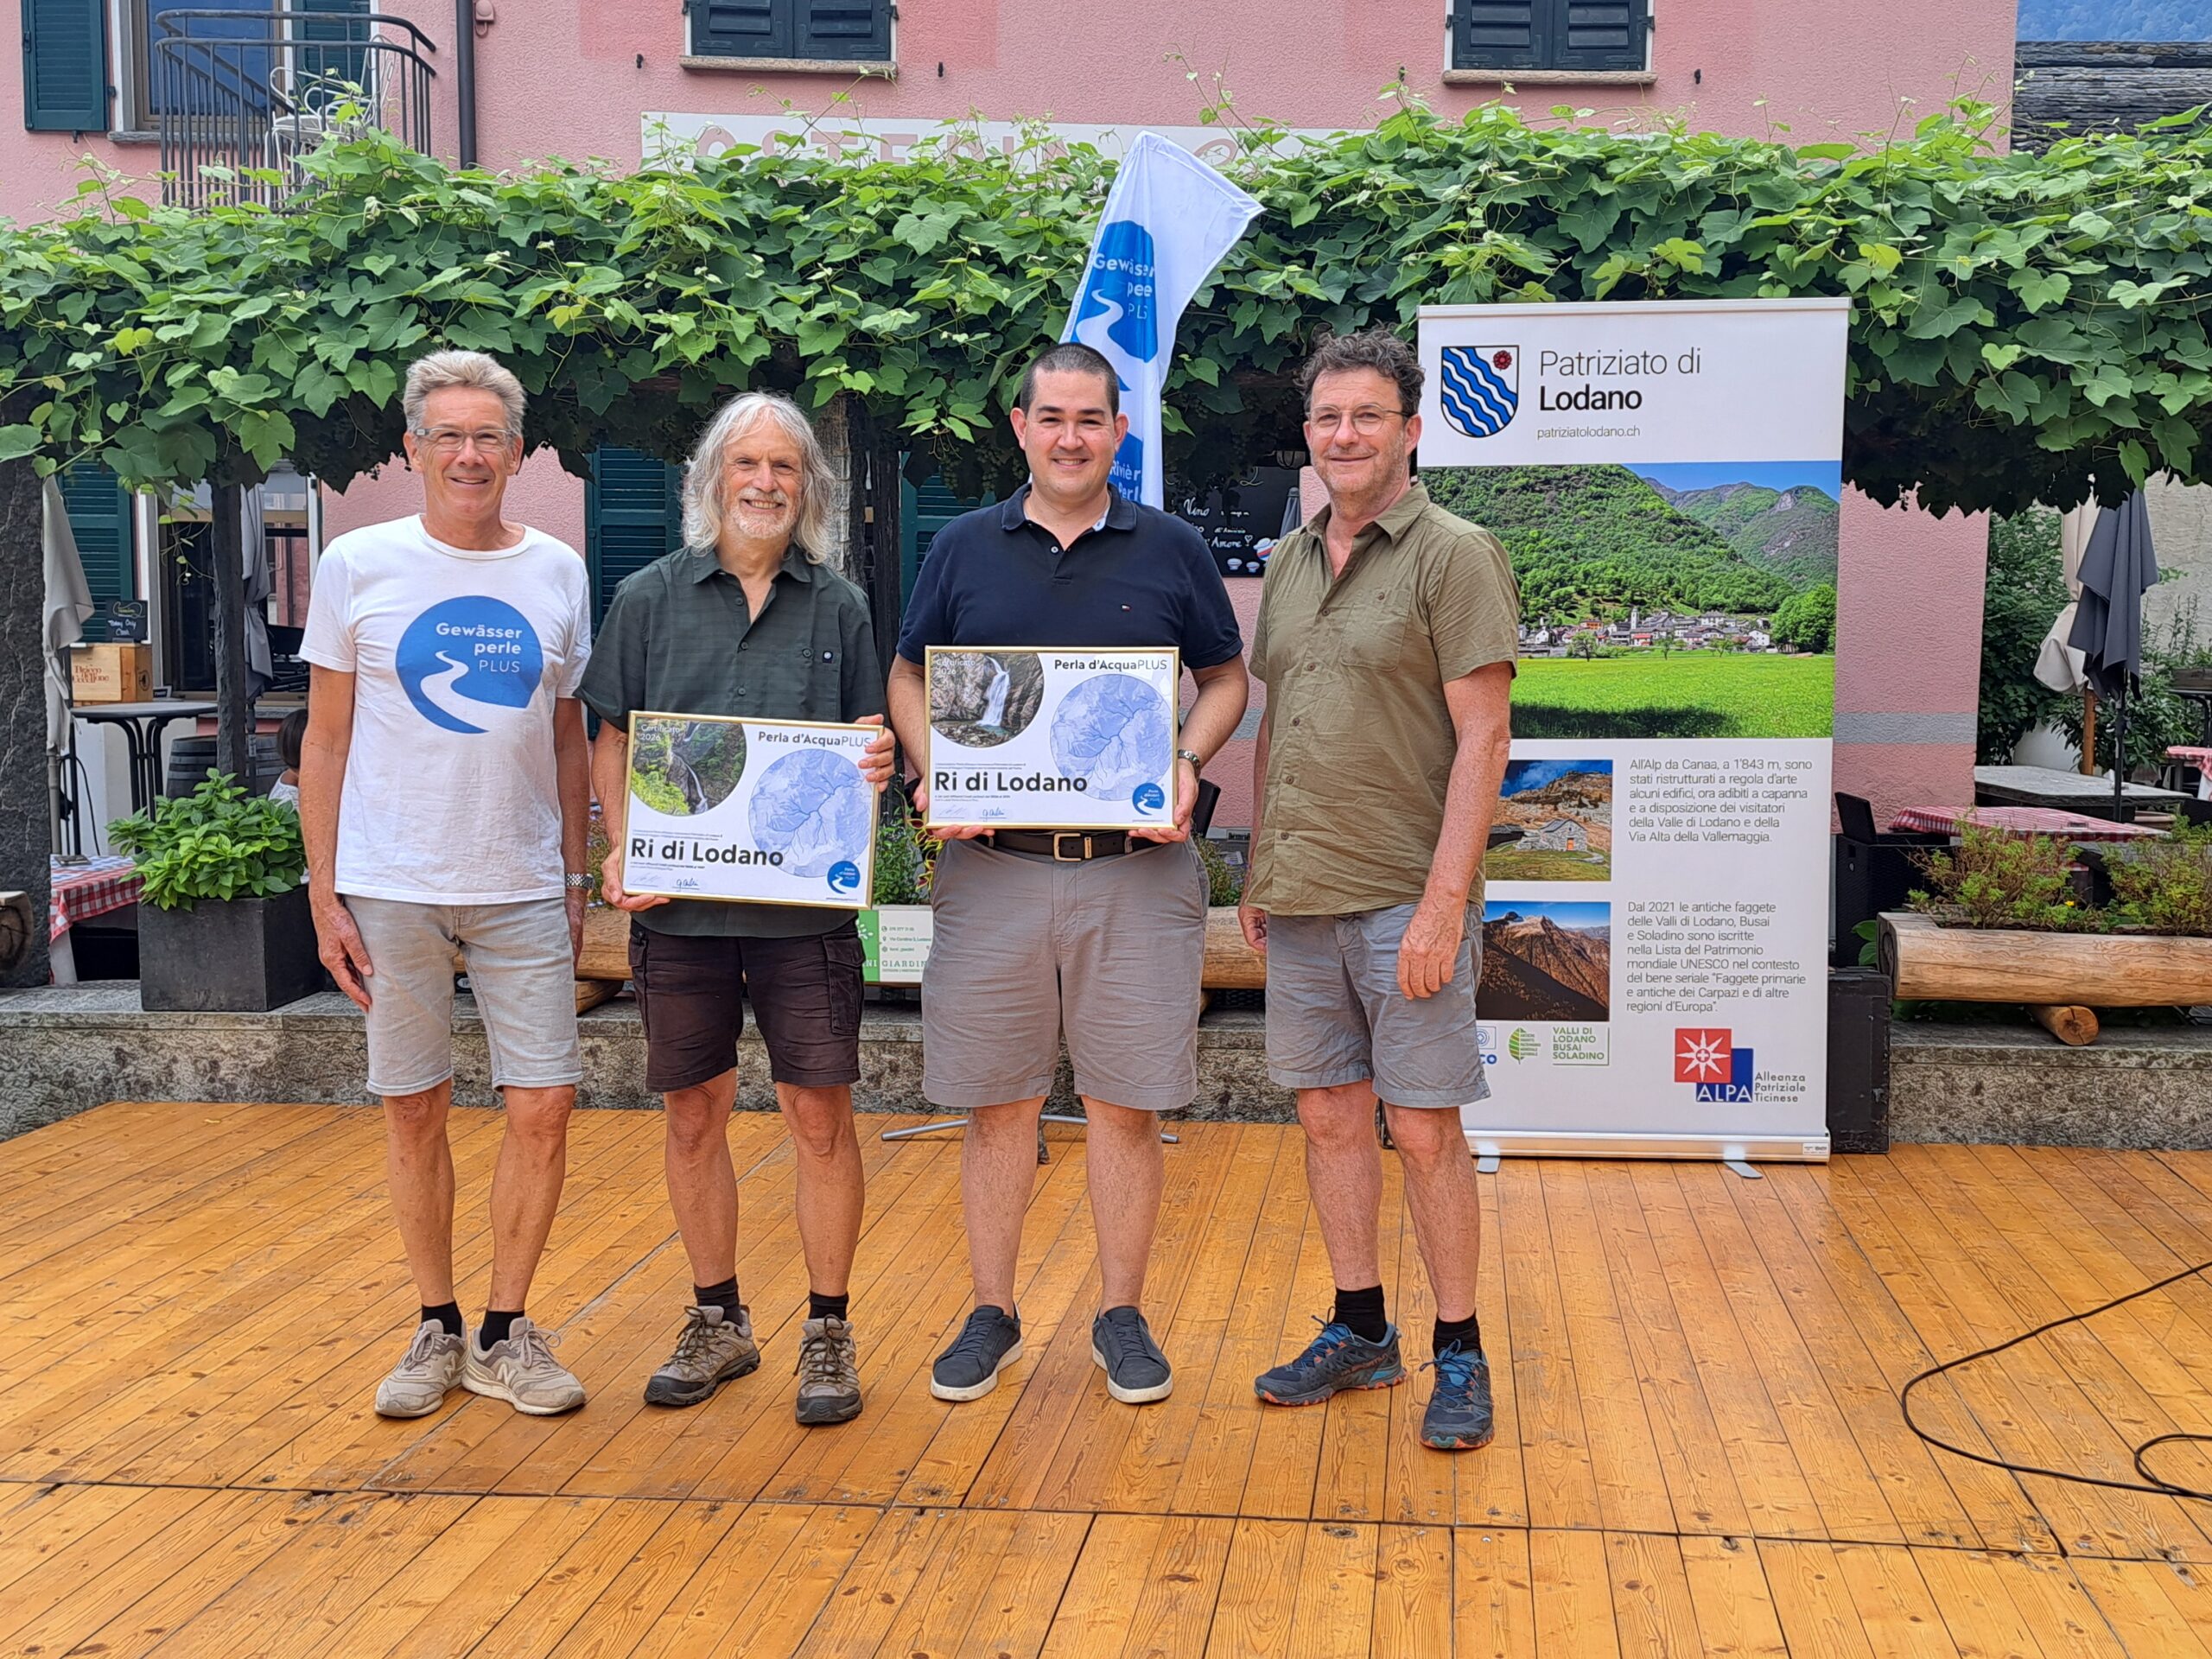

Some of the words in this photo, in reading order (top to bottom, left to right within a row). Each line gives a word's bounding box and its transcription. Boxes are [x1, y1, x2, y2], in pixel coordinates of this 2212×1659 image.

[1541, 349, 1667, 376] Patriziato
[1678, 346, 1700, 374] di
[1540, 384, 1642, 410] Lodano
[1537, 425, 1640, 440] patriziatolodano.ch
[435, 622, 522, 639] Gewässer
[475, 640, 521, 656] perle
[479, 659, 520, 672] PLUS
[1055, 659, 1084, 670] Perla
[1089, 660, 1166, 672] d'AcquaPLUS
[759, 731, 788, 742] Perla
[1665, 760, 1678, 769] da
[1682, 760, 1719, 770] Canaa,
[1734, 759, 1764, 769] 1'843
[1768, 761, 1781, 771] m,
[935, 772, 957, 791] Ri
[966, 772, 988, 791] di
[997, 771, 1088, 791] Lodano
[1630, 773, 1652, 784] stati
[1656, 773, 1715, 784] ristrutturati
[1729, 773, 1763, 785] regola
[1767, 773, 1797, 785] d'arte
[1630, 788, 1660, 798] alcuni
[1662, 788, 1695, 799] edifici,
[1719, 788, 1749, 798] adibiti
[1762, 791, 1808, 801] capanna
[1649, 802, 1717, 815] disposizione
[1720, 802, 1736, 812] dei
[1739, 803, 1784, 813] visitatori
[1629, 817, 1654, 827] della
[1658, 817, 1683, 827] Valle
[1687, 817, 1695, 827] di
[1700, 817, 1740, 827] Lodano
[1754, 817, 1779, 828] della
[1629, 831, 1646, 842] Via
[1649, 831, 1670, 842] Alta
[1674, 831, 1699, 842] della
[1702, 831, 1771, 844] Vallemaggia.
[632, 838, 653, 857] Ri
[662, 841, 684, 860] di
[693, 841, 783, 867] Lodano
[1629, 902, 1645, 912] Dal
[1649, 901, 1674, 912] 2021
[1680, 902, 1688, 912] le
[1692, 901, 1732, 912] antiche
[1736, 901, 1776, 914] faggete
[1628, 916, 1653, 926] delle
[1656, 916, 1676, 926] Valli
[1681, 916, 1689, 926] di
[1694, 916, 1736, 927] Lodano,
[1740, 916, 1770, 926] Busai
[1637, 930, 1684, 940] Soladino
[1719, 931, 1754, 940] iscritte
[1628, 944, 1652, 955] nella
[1656, 944, 1681, 955] Lista
[1685, 944, 1700, 955] del
[1705, 944, 1764, 955] Patrimonio
[1627, 958, 1677, 969] mondiale
[1681, 959, 1729, 969] UNESCO
[1733, 959, 1748, 969] nel
[1752, 961, 1799, 969] contesto
[1627, 972, 1642, 982] del
[1646, 972, 1672, 982] bene
[1675, 972, 1709, 983] seriale
[1762, 974, 1806, 985] primarie
[1637, 987, 1675, 997] antiche
[1679, 987, 1694, 997] dei
[1699, 987, 1738, 999] Carpazi
[1752, 987, 1762, 997] di
[1765, 987, 1789, 998] altre
[1627, 1001, 1662, 1014] regioni
[1755, 1071, 1805, 1081] Alleanza
[1697, 1084, 1752, 1102] ALPA
[1755, 1082, 1805, 1091] Patriziale
[1754, 1092, 1798, 1102] Ticinese
